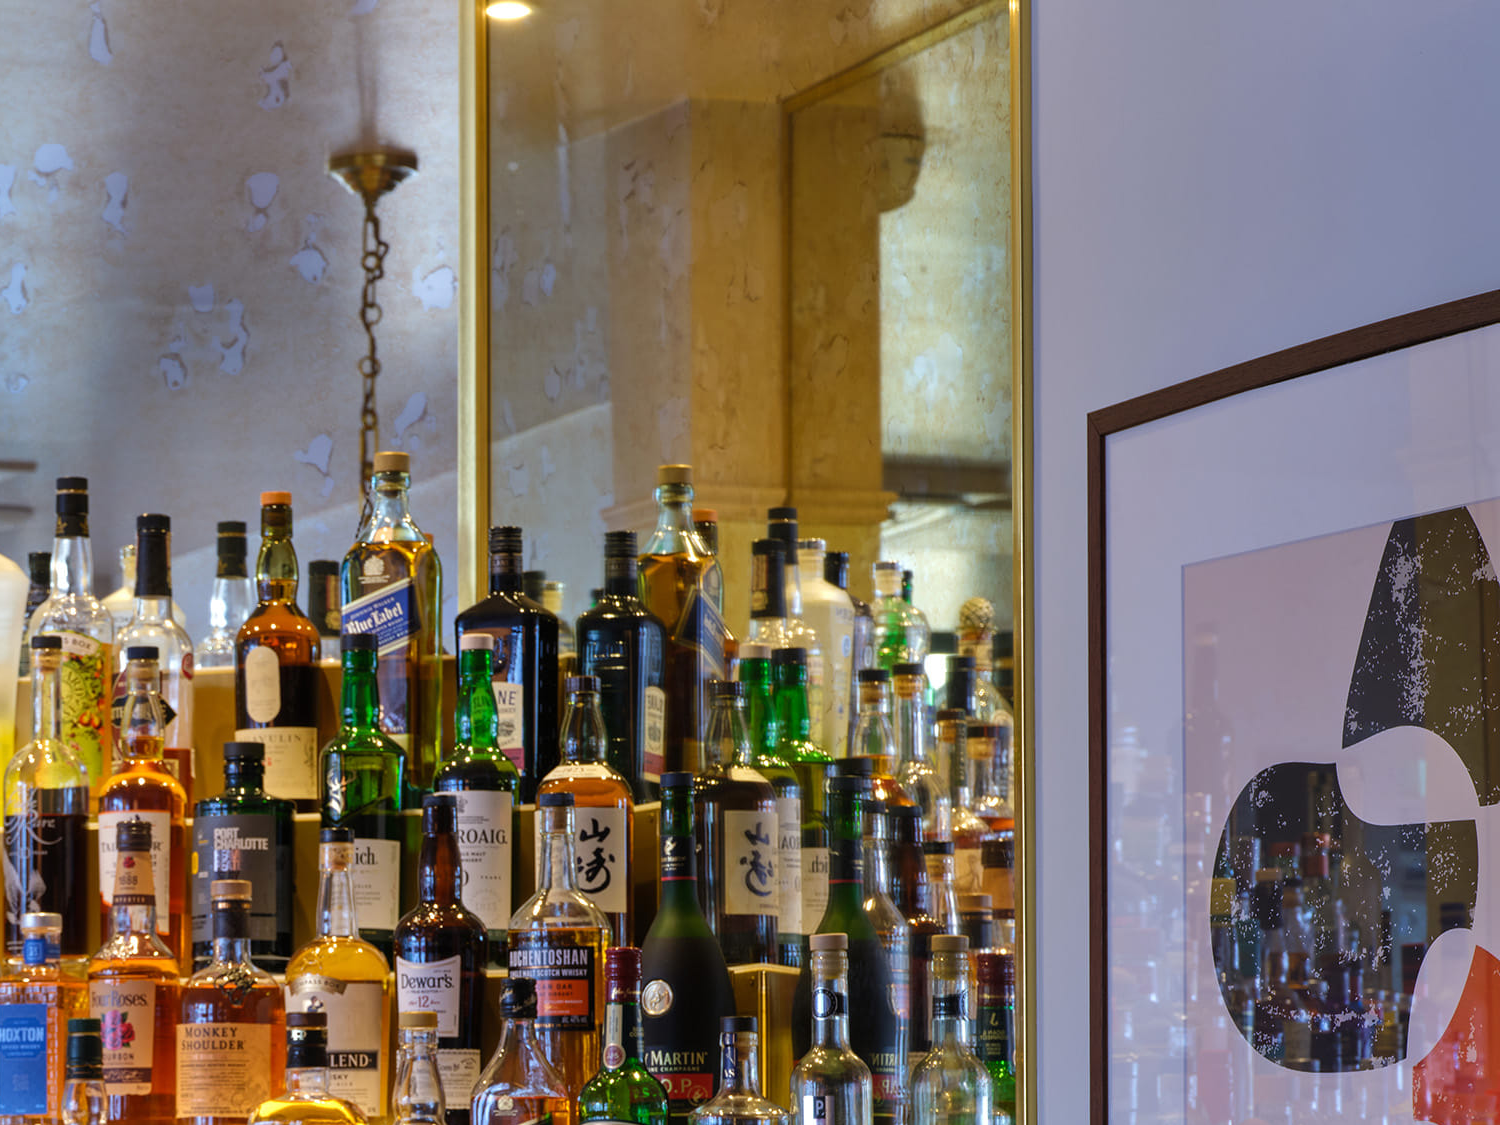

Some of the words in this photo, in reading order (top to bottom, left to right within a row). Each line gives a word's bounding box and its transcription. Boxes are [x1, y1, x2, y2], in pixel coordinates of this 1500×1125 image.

[372, 602, 404, 627] Label
[213, 838, 269, 851] CHARLOTTE
[510, 948, 588, 968] AUCHENTOSHAN
[401, 973, 453, 990] Dewar's
[417, 995, 430, 1009] 12
[185, 1026, 238, 1038] MONKEY
[181, 1040, 244, 1051] SHOULDER
[102, 1053, 135, 1061] OURBON
[329, 1053, 370, 1068] LEND
